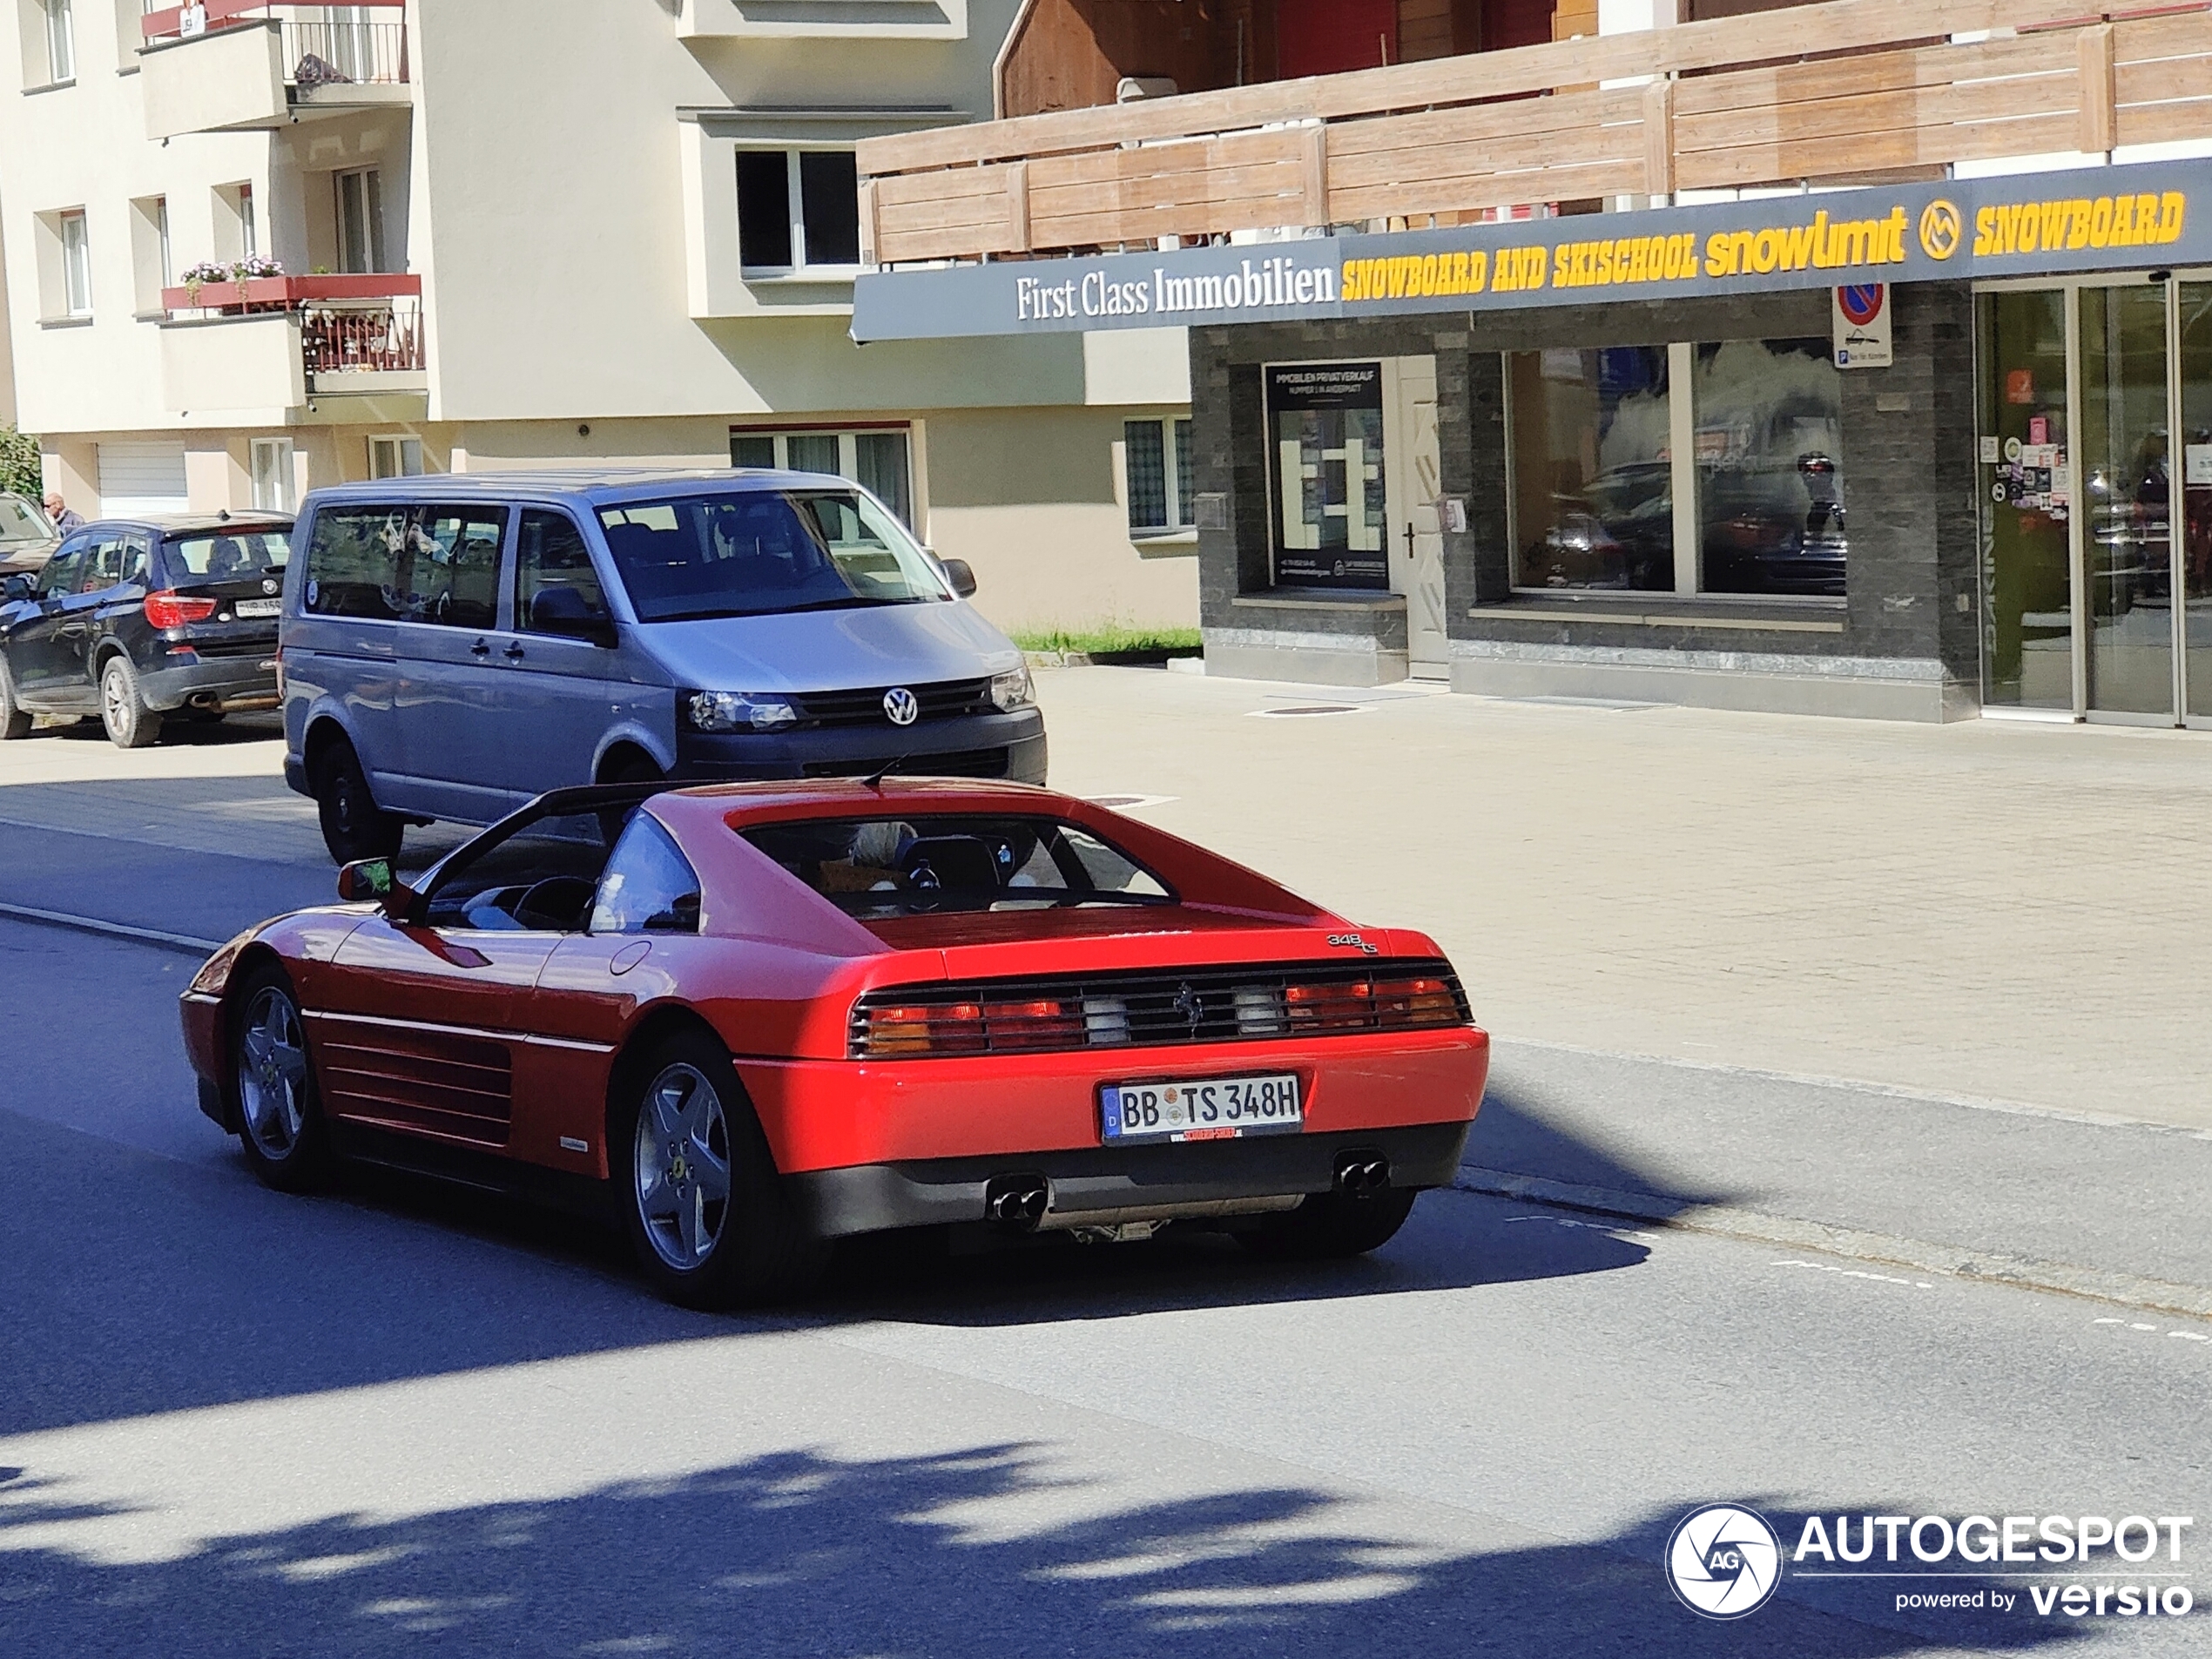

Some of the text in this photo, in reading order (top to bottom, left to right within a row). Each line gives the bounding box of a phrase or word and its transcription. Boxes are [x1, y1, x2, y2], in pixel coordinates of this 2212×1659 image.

[1704, 206, 1909, 277] snowlimit
[1973, 191, 2185, 257] SNOWBOARD
[1016, 258, 1335, 320] First Class Immobilien
[1341, 233, 1698, 301] SNOWBOARD AND SKISCHOOL
[1109, 1116, 1116, 1127] D
[1122, 1081, 1296, 1128] BB TS 348H
